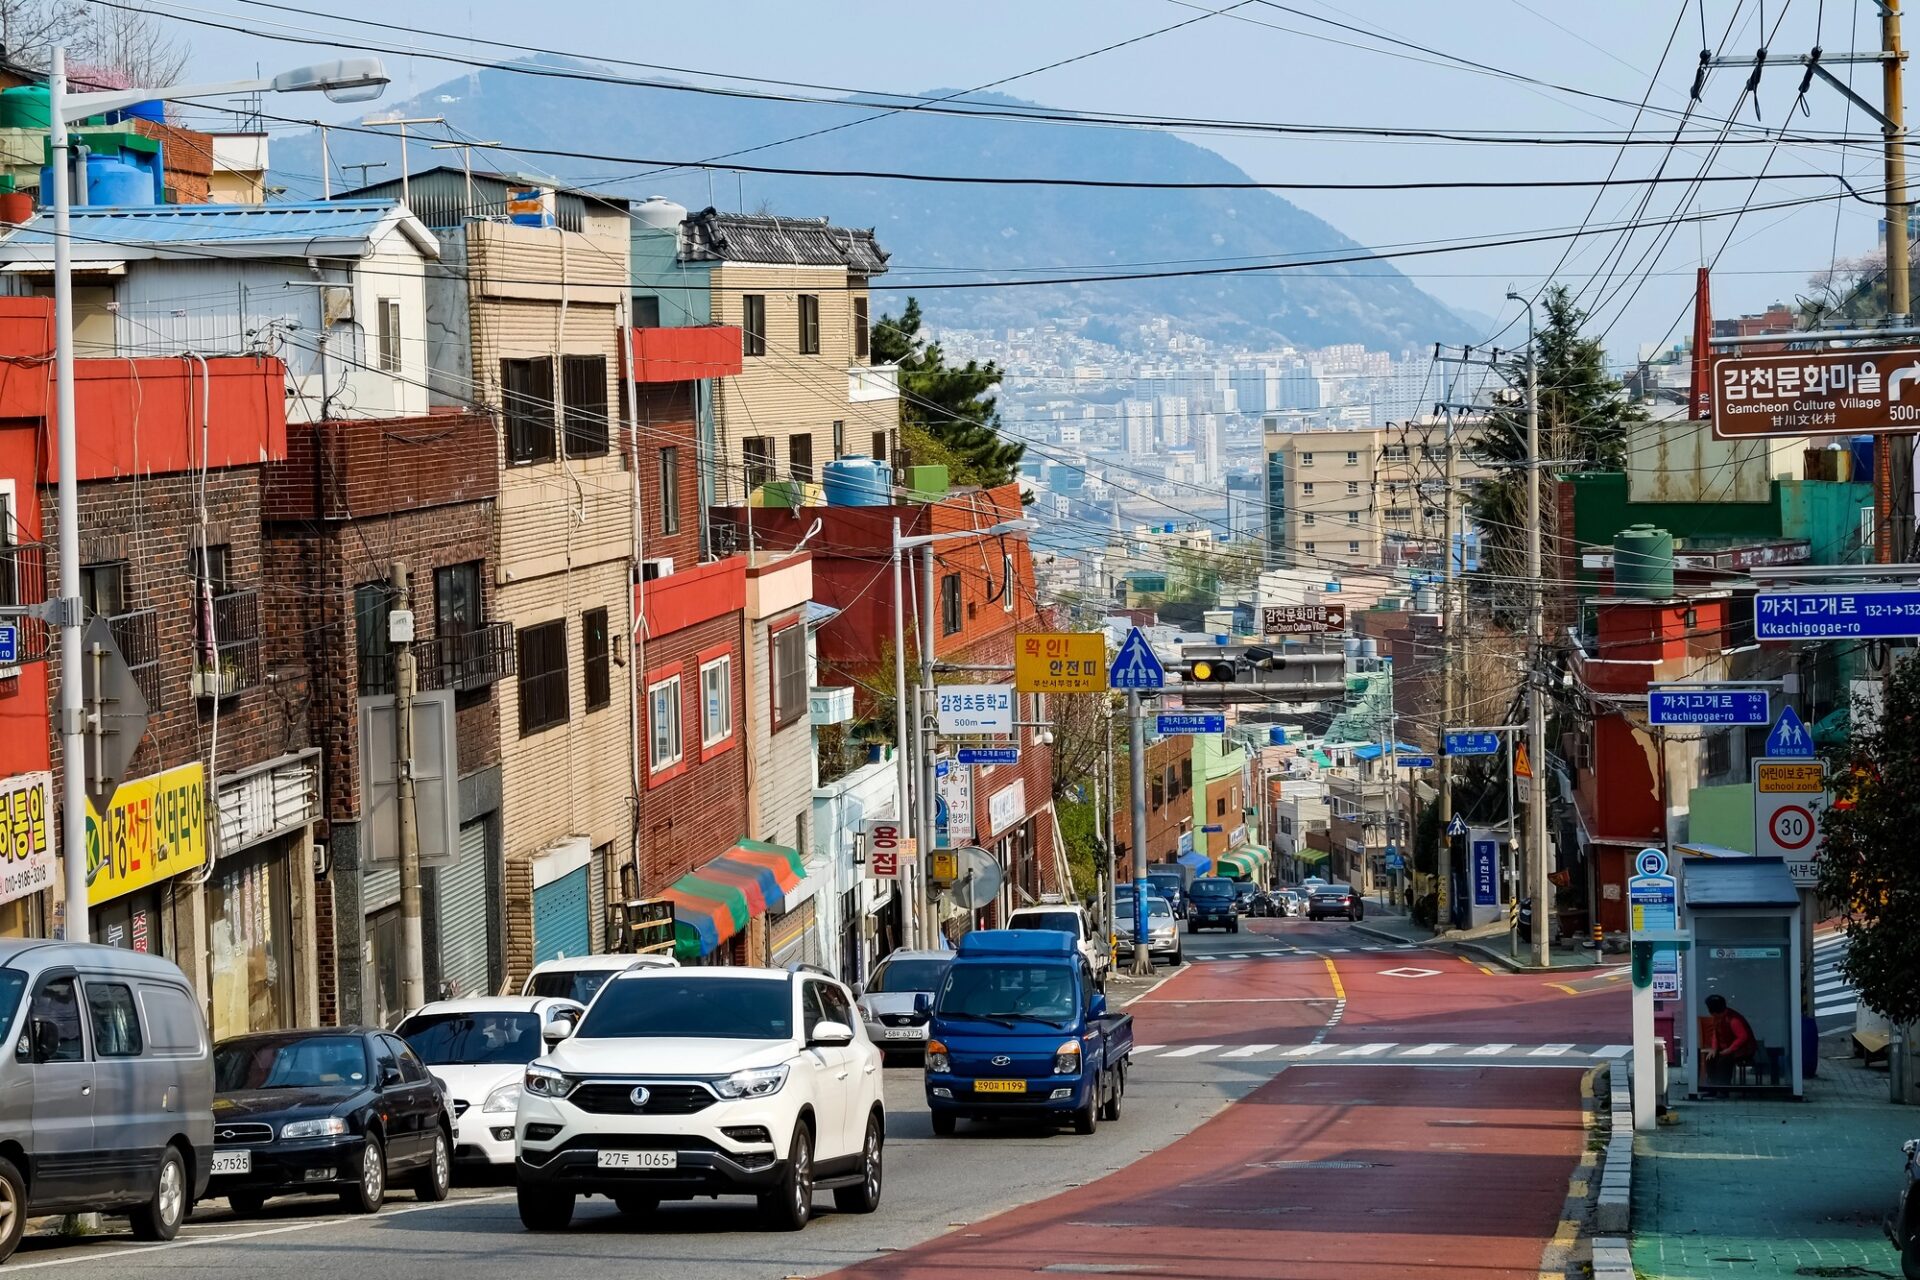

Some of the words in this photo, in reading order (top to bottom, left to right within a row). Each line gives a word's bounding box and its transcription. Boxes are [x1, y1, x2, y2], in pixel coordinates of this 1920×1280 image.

[1724, 361, 1881, 400] 감천문화마을
[1726, 402, 1789, 415] Gamcheon
[1793, 399, 1836, 411] Culture
[1840, 398, 1881, 410] Village
[1771, 412, 1836, 427] 甘川文化村
[1761, 598, 1857, 616] 까치고개로
[1266, 606, 1327, 623] 감천문화마을
[1762, 623, 1860, 635] Kkachigogae-ro
[1050, 660, 1096, 676] 안전띠
[941, 694, 1008, 712] 감정초등학교
[1663, 696, 1733, 708] 까치고개로
[1748, 695, 1762, 703] 262
[954, 719, 978, 727] 500m
[1661, 711, 1734, 722] Kkachigogae-ro
[1761, 767, 1821, 780] 어린이보호구역
[1765, 782, 1794, 791] school
[1781, 819, 1802, 836] 30
[872, 826, 898, 875] 용접
[1001, 1081, 1023, 1090] 1199
[605, 1152, 629, 1165] 27두
[637, 1153, 669, 1166] 1065
